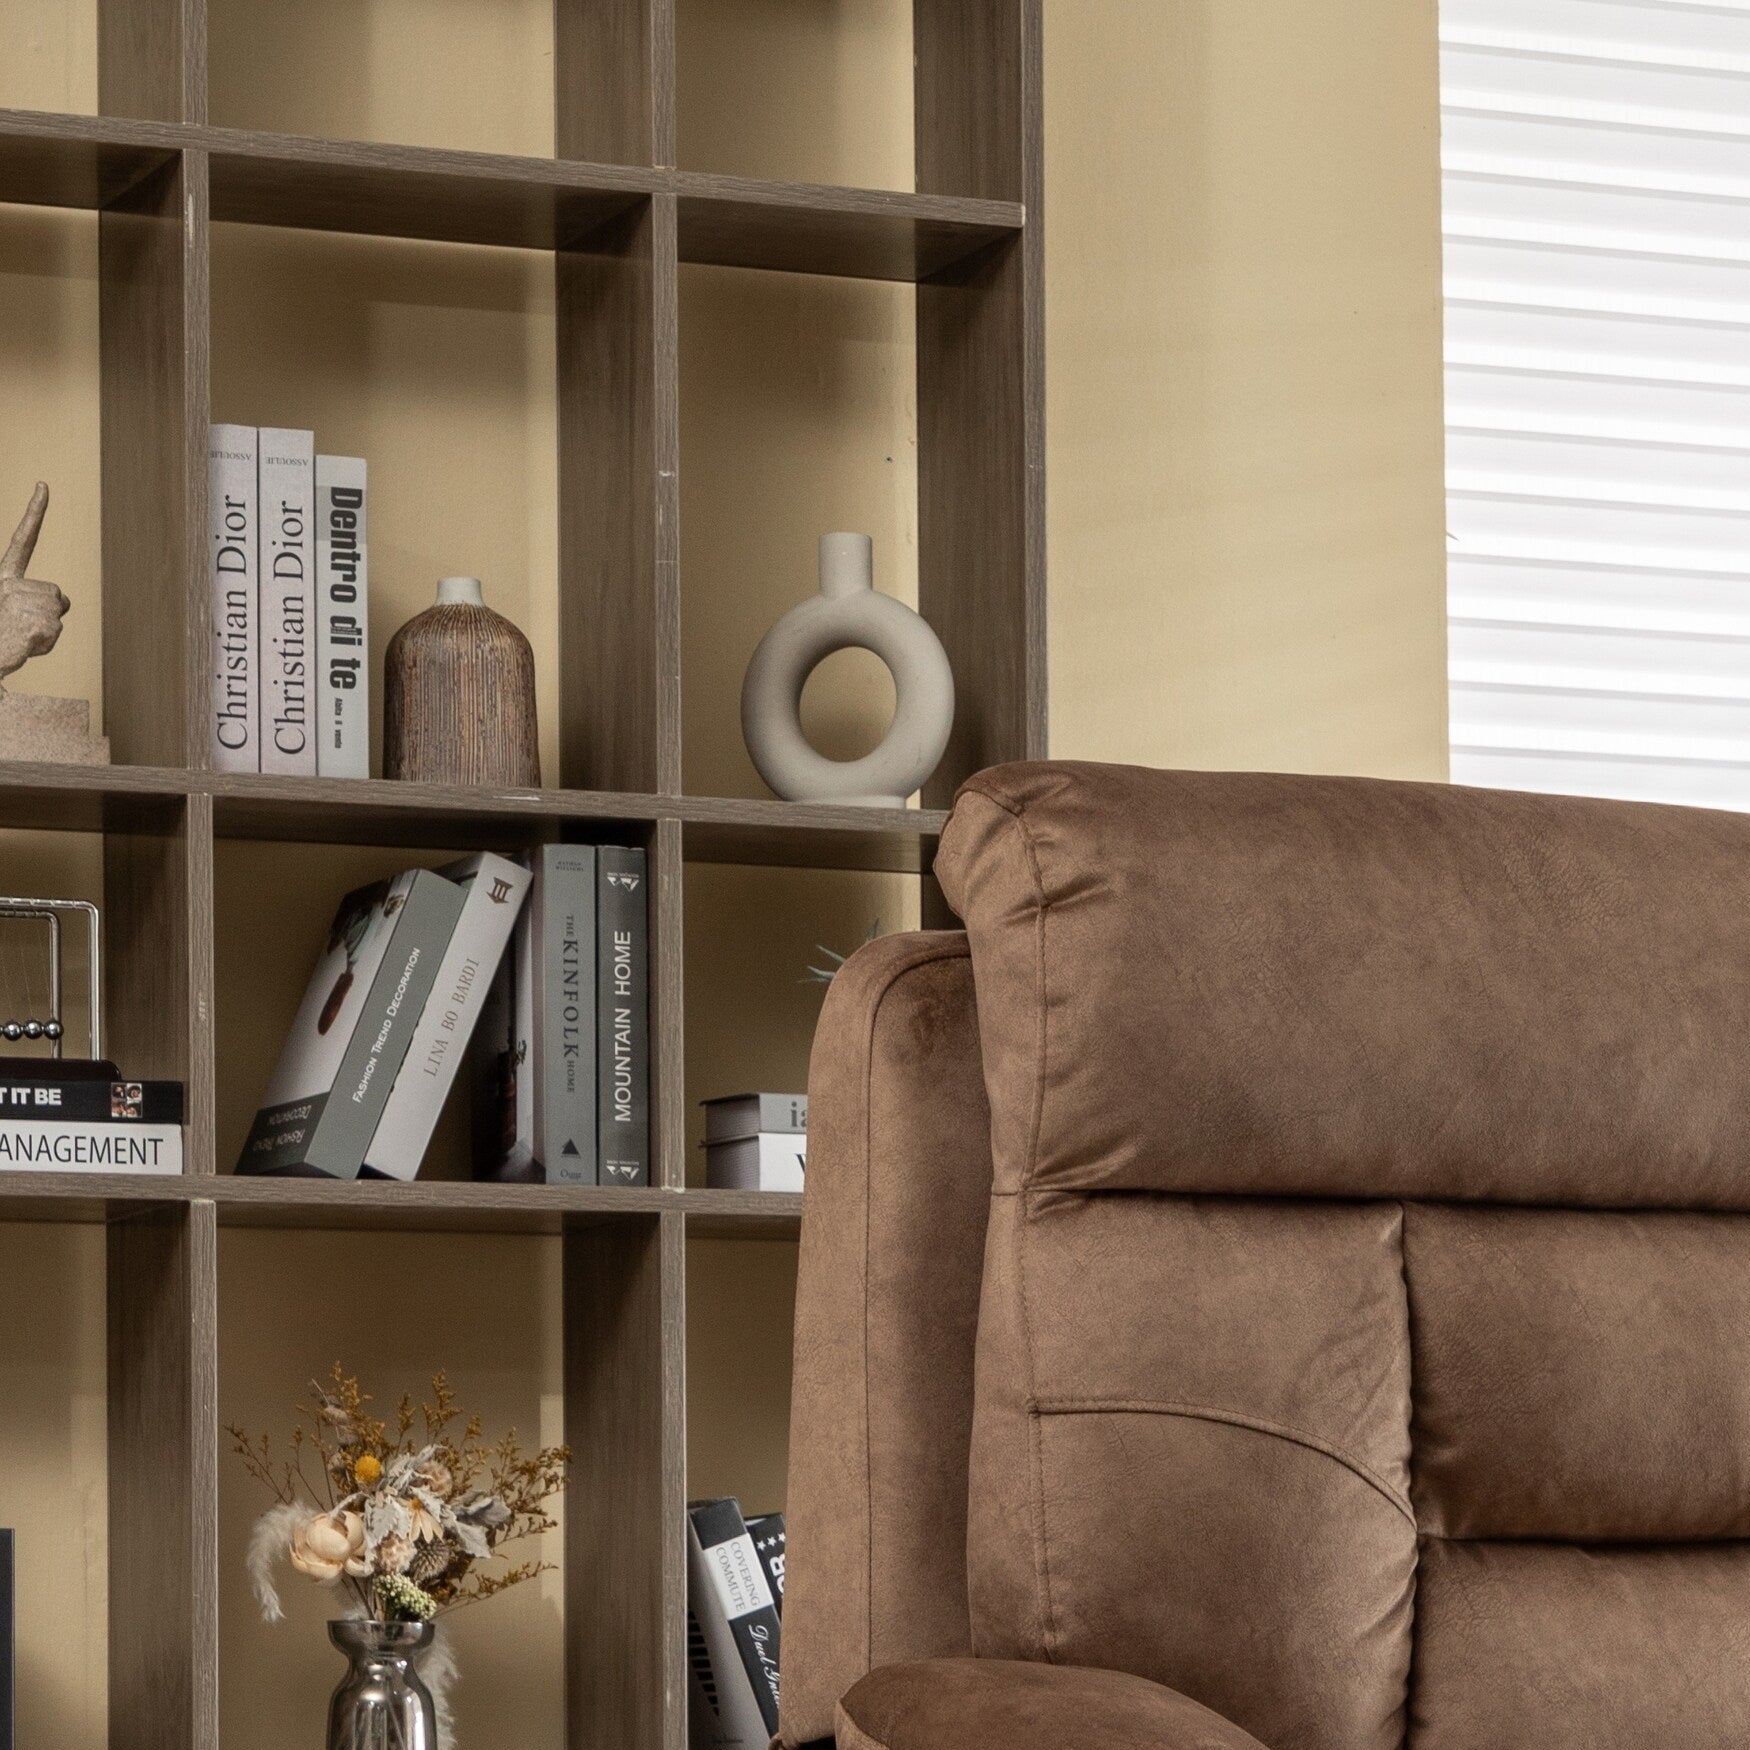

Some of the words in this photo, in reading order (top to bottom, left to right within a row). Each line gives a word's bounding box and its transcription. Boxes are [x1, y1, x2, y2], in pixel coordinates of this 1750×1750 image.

[215, 494, 247, 576] Dior
[272, 500, 304, 582] Dior
[330, 486, 362, 603] Dentro
[216, 589, 248, 750] Christian
[330, 615, 362, 646] di
[273, 595, 306, 755] Christian
[330, 657, 361, 689] te
[566, 914, 574, 936] THE
[614, 930, 631, 995] HOME
[352, 1057, 377, 1103] FASHION
[371, 1019, 392, 1054] TREND
[386, 947, 420, 1017] DECORATION
[423, 1038, 449, 1077] LINA
[441, 1010, 458, 1031] BO
[452, 957, 480, 1005] BARDI
[563, 939, 579, 1057] KINFOLK
[11, 1087, 30, 1104] IT
[34, 1088, 62, 1106] BE
[567, 1060, 575, 1093] HOME
[614, 1008, 632, 1122] MOUNTAIN
[715, 1546, 747, 1612] COMMUTE
[731, 1541, 760, 1607] COVERING
